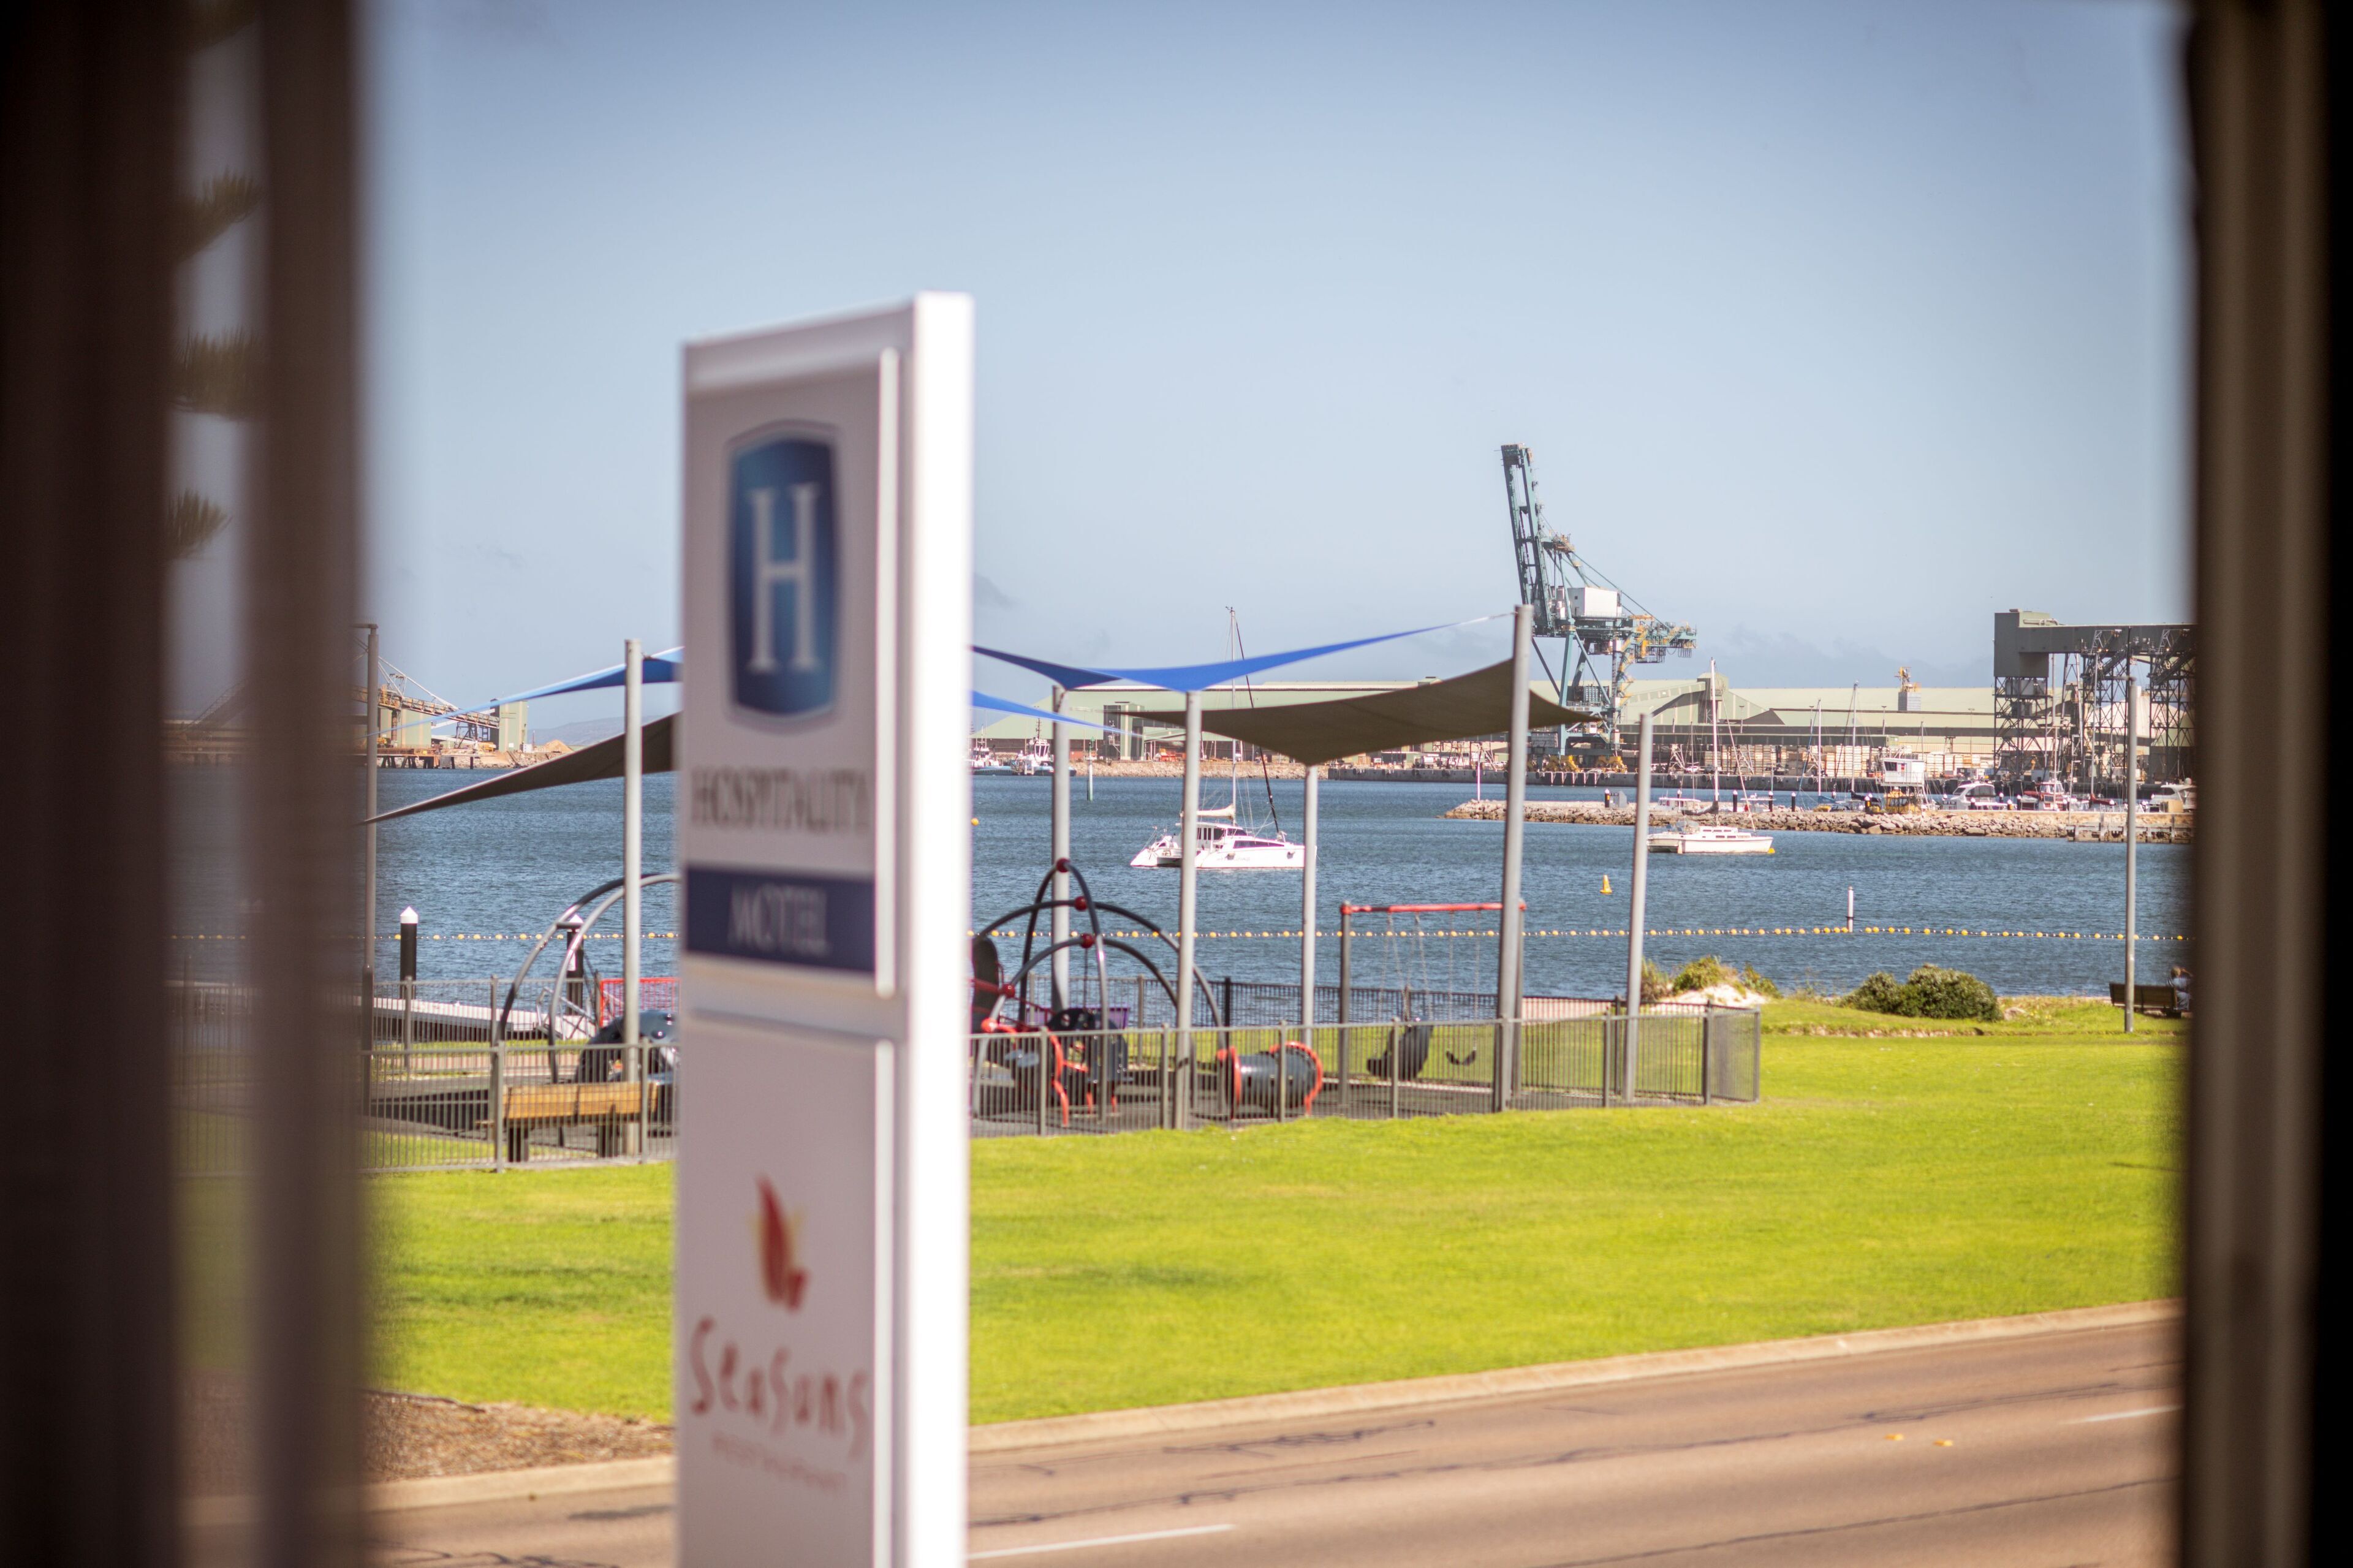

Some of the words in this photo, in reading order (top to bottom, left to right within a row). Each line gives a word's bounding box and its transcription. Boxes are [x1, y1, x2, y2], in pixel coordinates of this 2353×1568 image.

[749, 483, 822, 670] H
[691, 766, 870, 834] HOSPITALITY
[728, 883, 832, 955] MOTEL
